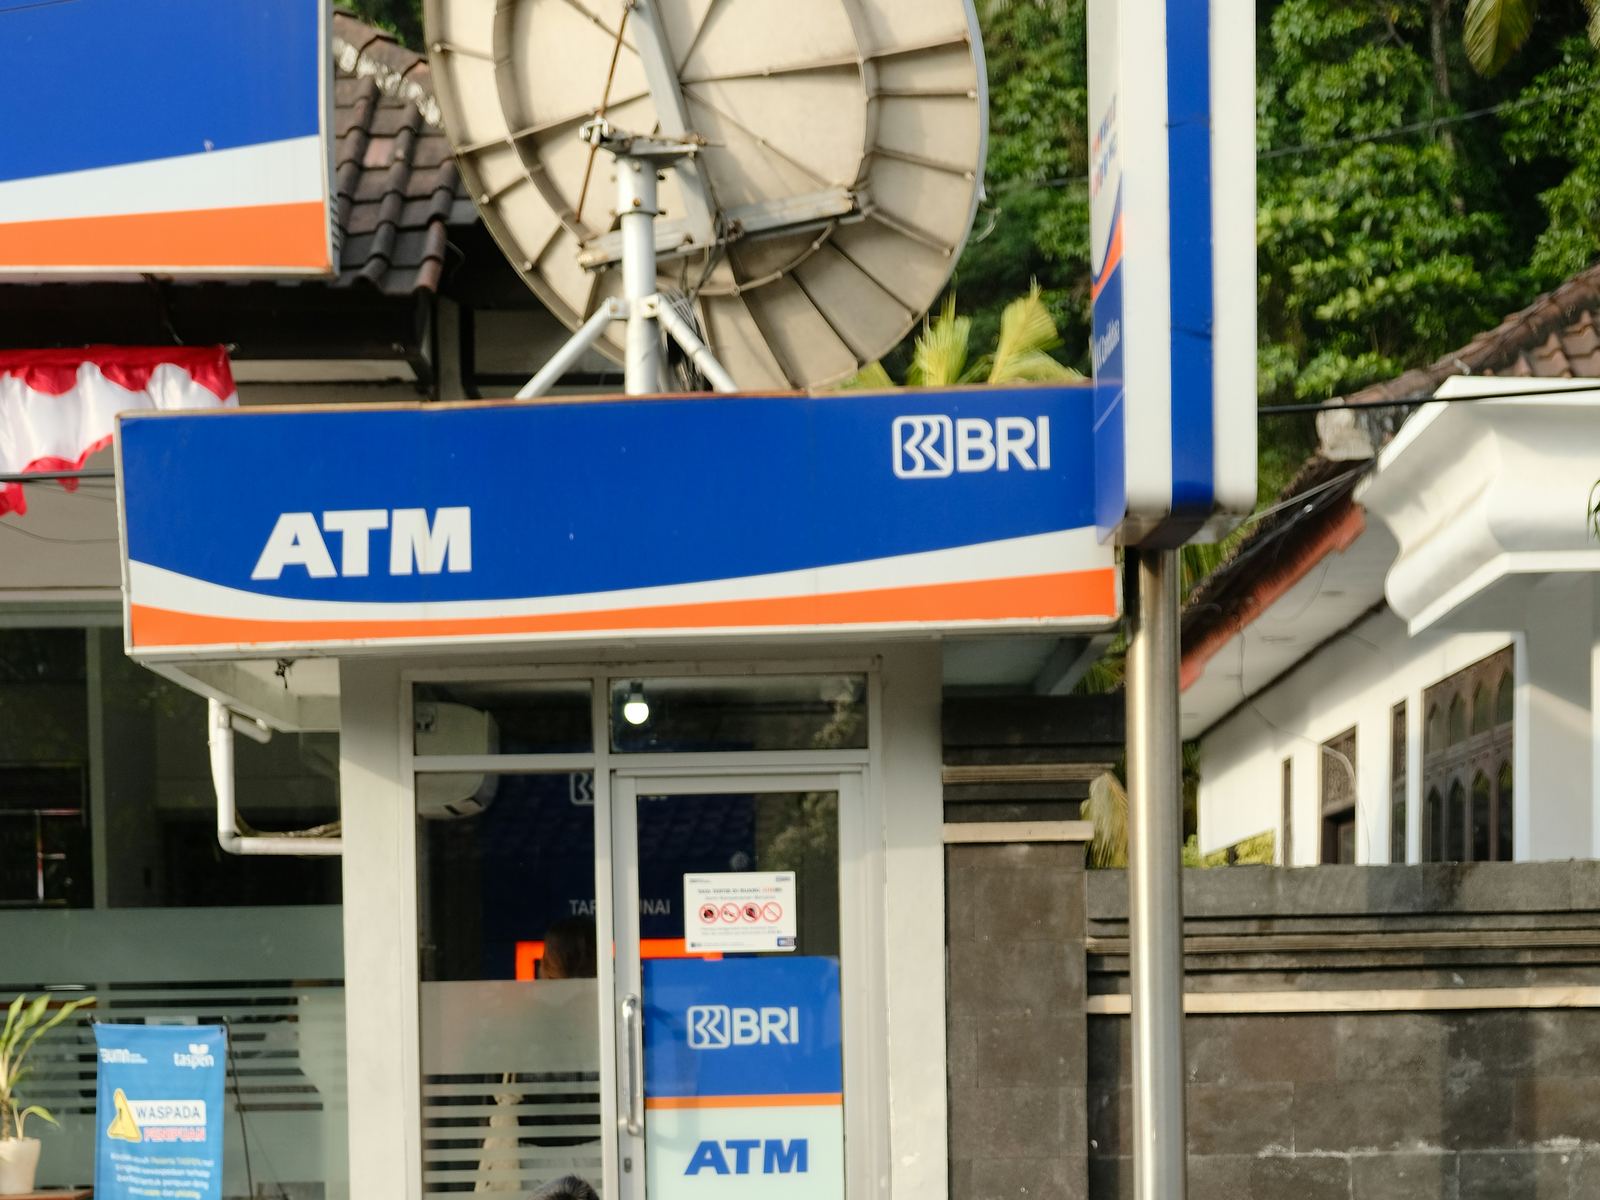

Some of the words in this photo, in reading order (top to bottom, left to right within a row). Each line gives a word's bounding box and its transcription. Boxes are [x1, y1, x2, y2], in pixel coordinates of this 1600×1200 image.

[956, 416, 1050, 472] BRI
[251, 506, 472, 580] ATM
[732, 1007, 799, 1045] BRI
[136, 1106, 200, 1119] WASPADA
[684, 1139, 808, 1175] ATM
